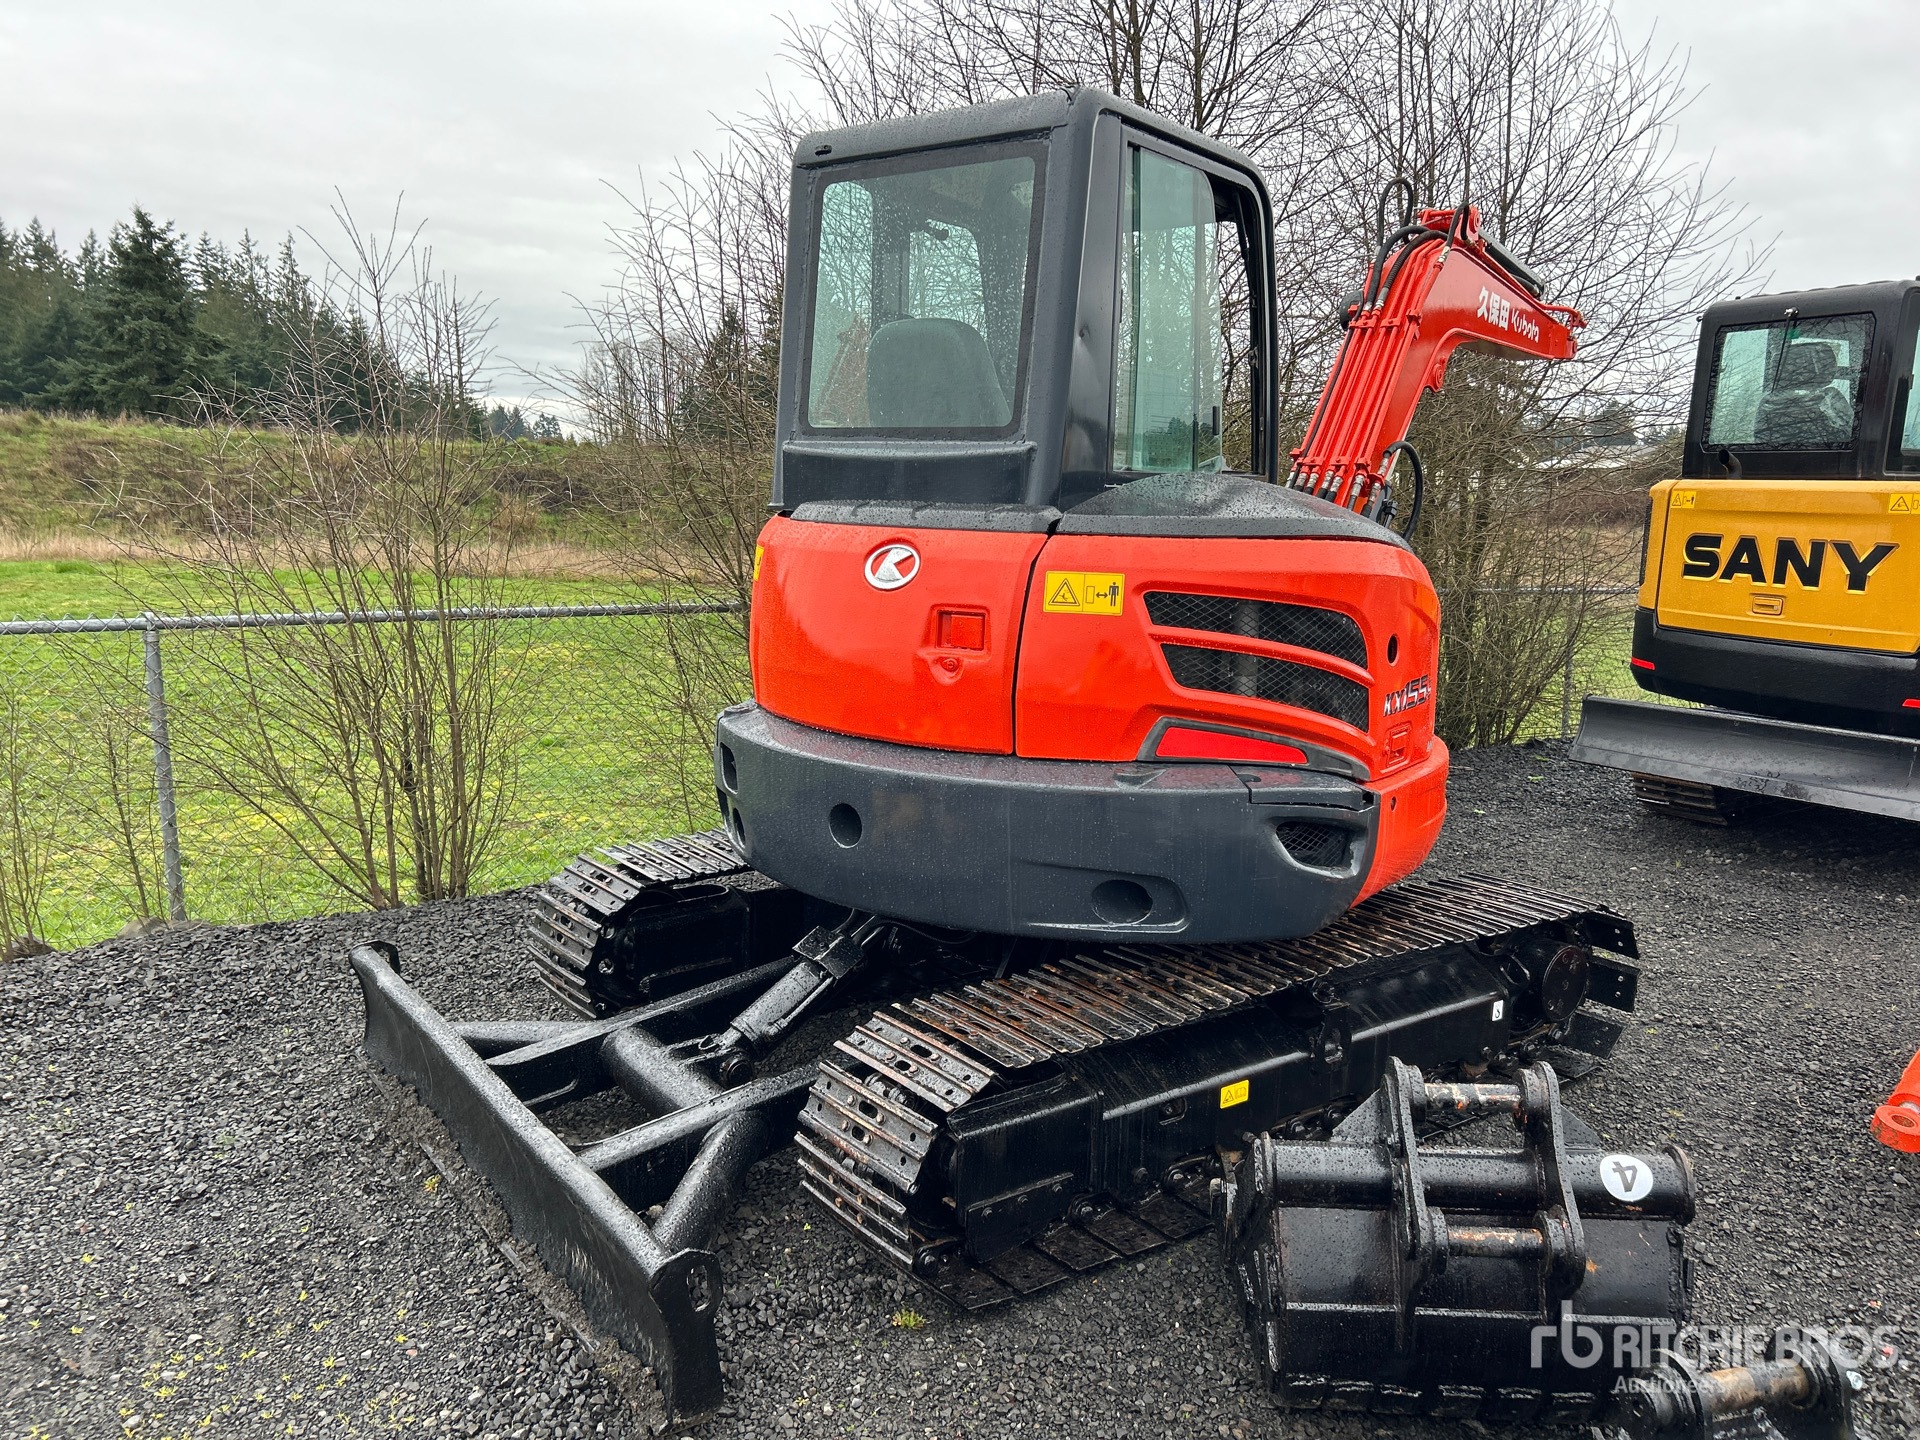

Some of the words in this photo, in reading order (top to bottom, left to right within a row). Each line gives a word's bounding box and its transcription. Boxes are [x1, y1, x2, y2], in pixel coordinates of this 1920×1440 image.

[1477, 286, 1510, 331] 久保田
[1511, 308, 1540, 343] Kubota
[1682, 533, 1899, 593] SANY
[1611, 1161, 1638, 1193] 4
